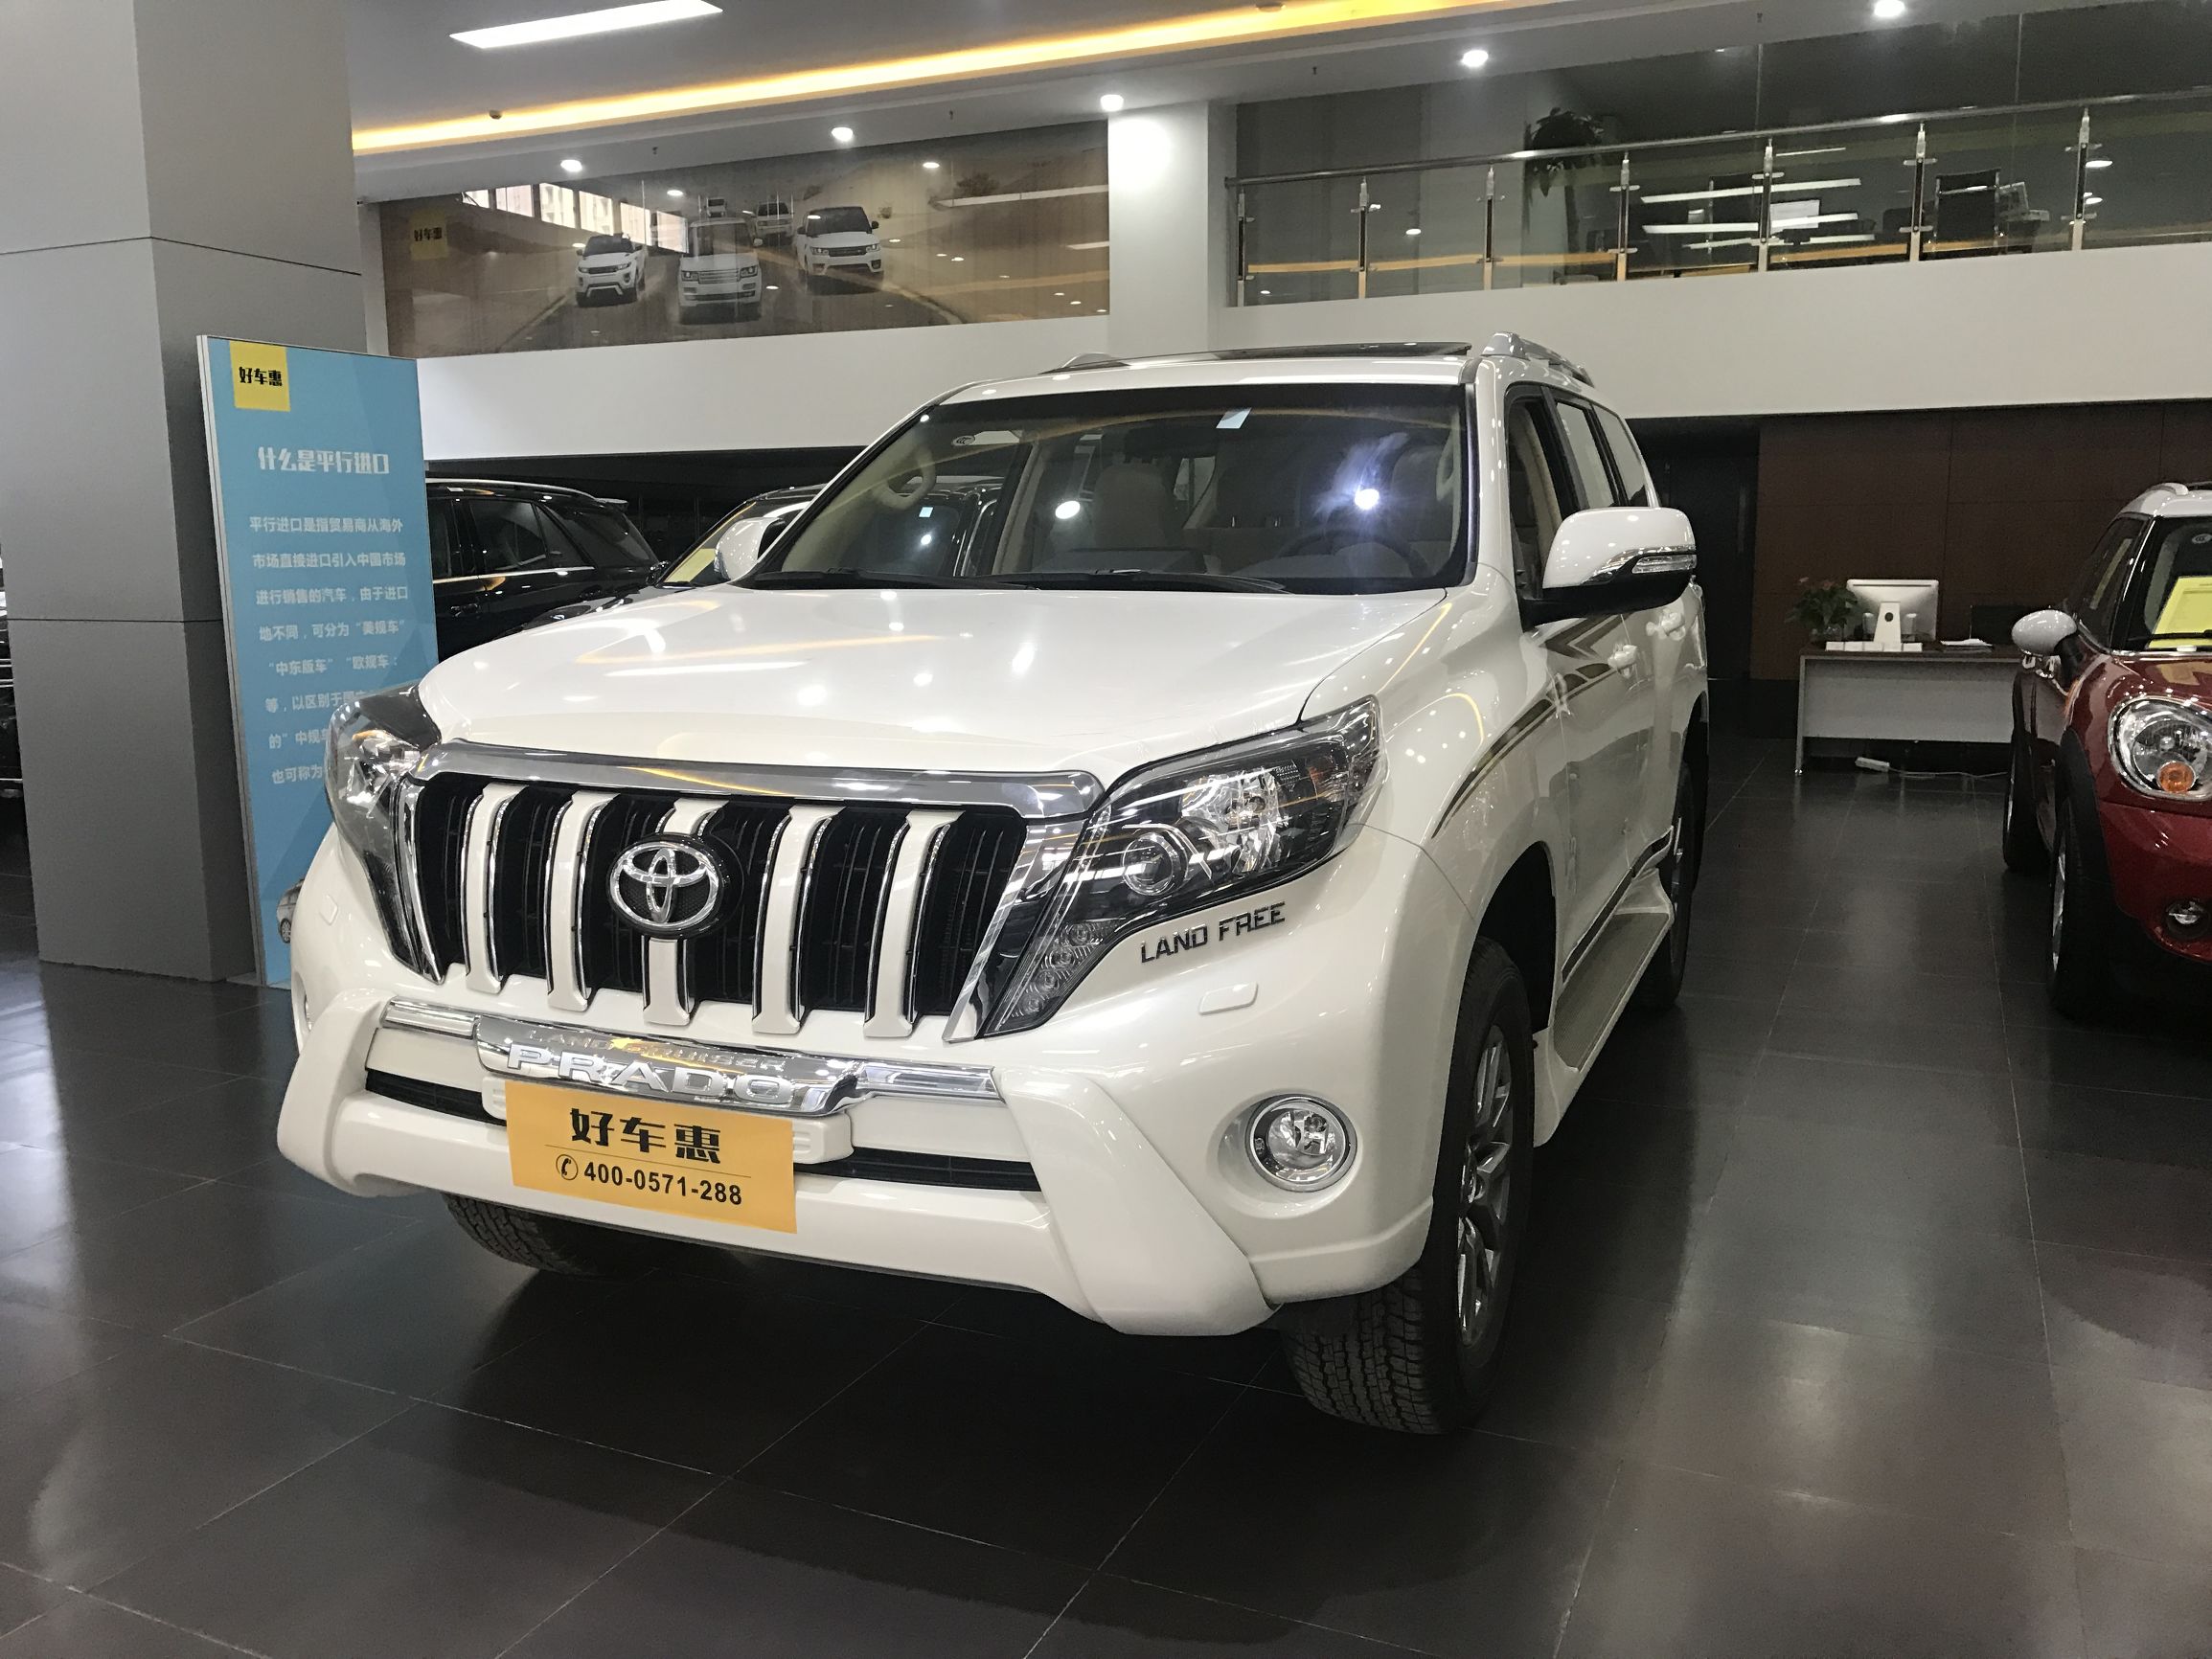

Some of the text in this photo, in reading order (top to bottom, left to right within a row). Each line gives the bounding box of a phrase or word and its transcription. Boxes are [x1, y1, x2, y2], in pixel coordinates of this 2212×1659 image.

[239, 366, 283, 386] 好车惠
[258, 446, 390, 474] 什么是平行进口
[249, 516, 403, 533] 平行进口是指贸易商从海外
[252, 552, 406, 569] 市场直接进口引入中国市场
[1141, 900, 1286, 963] LAND FREE
[507, 1043, 794, 1103] PRADO
[570, 1108, 721, 1164] 好车惠
[583, 1161, 742, 1206] 400-0571-288
